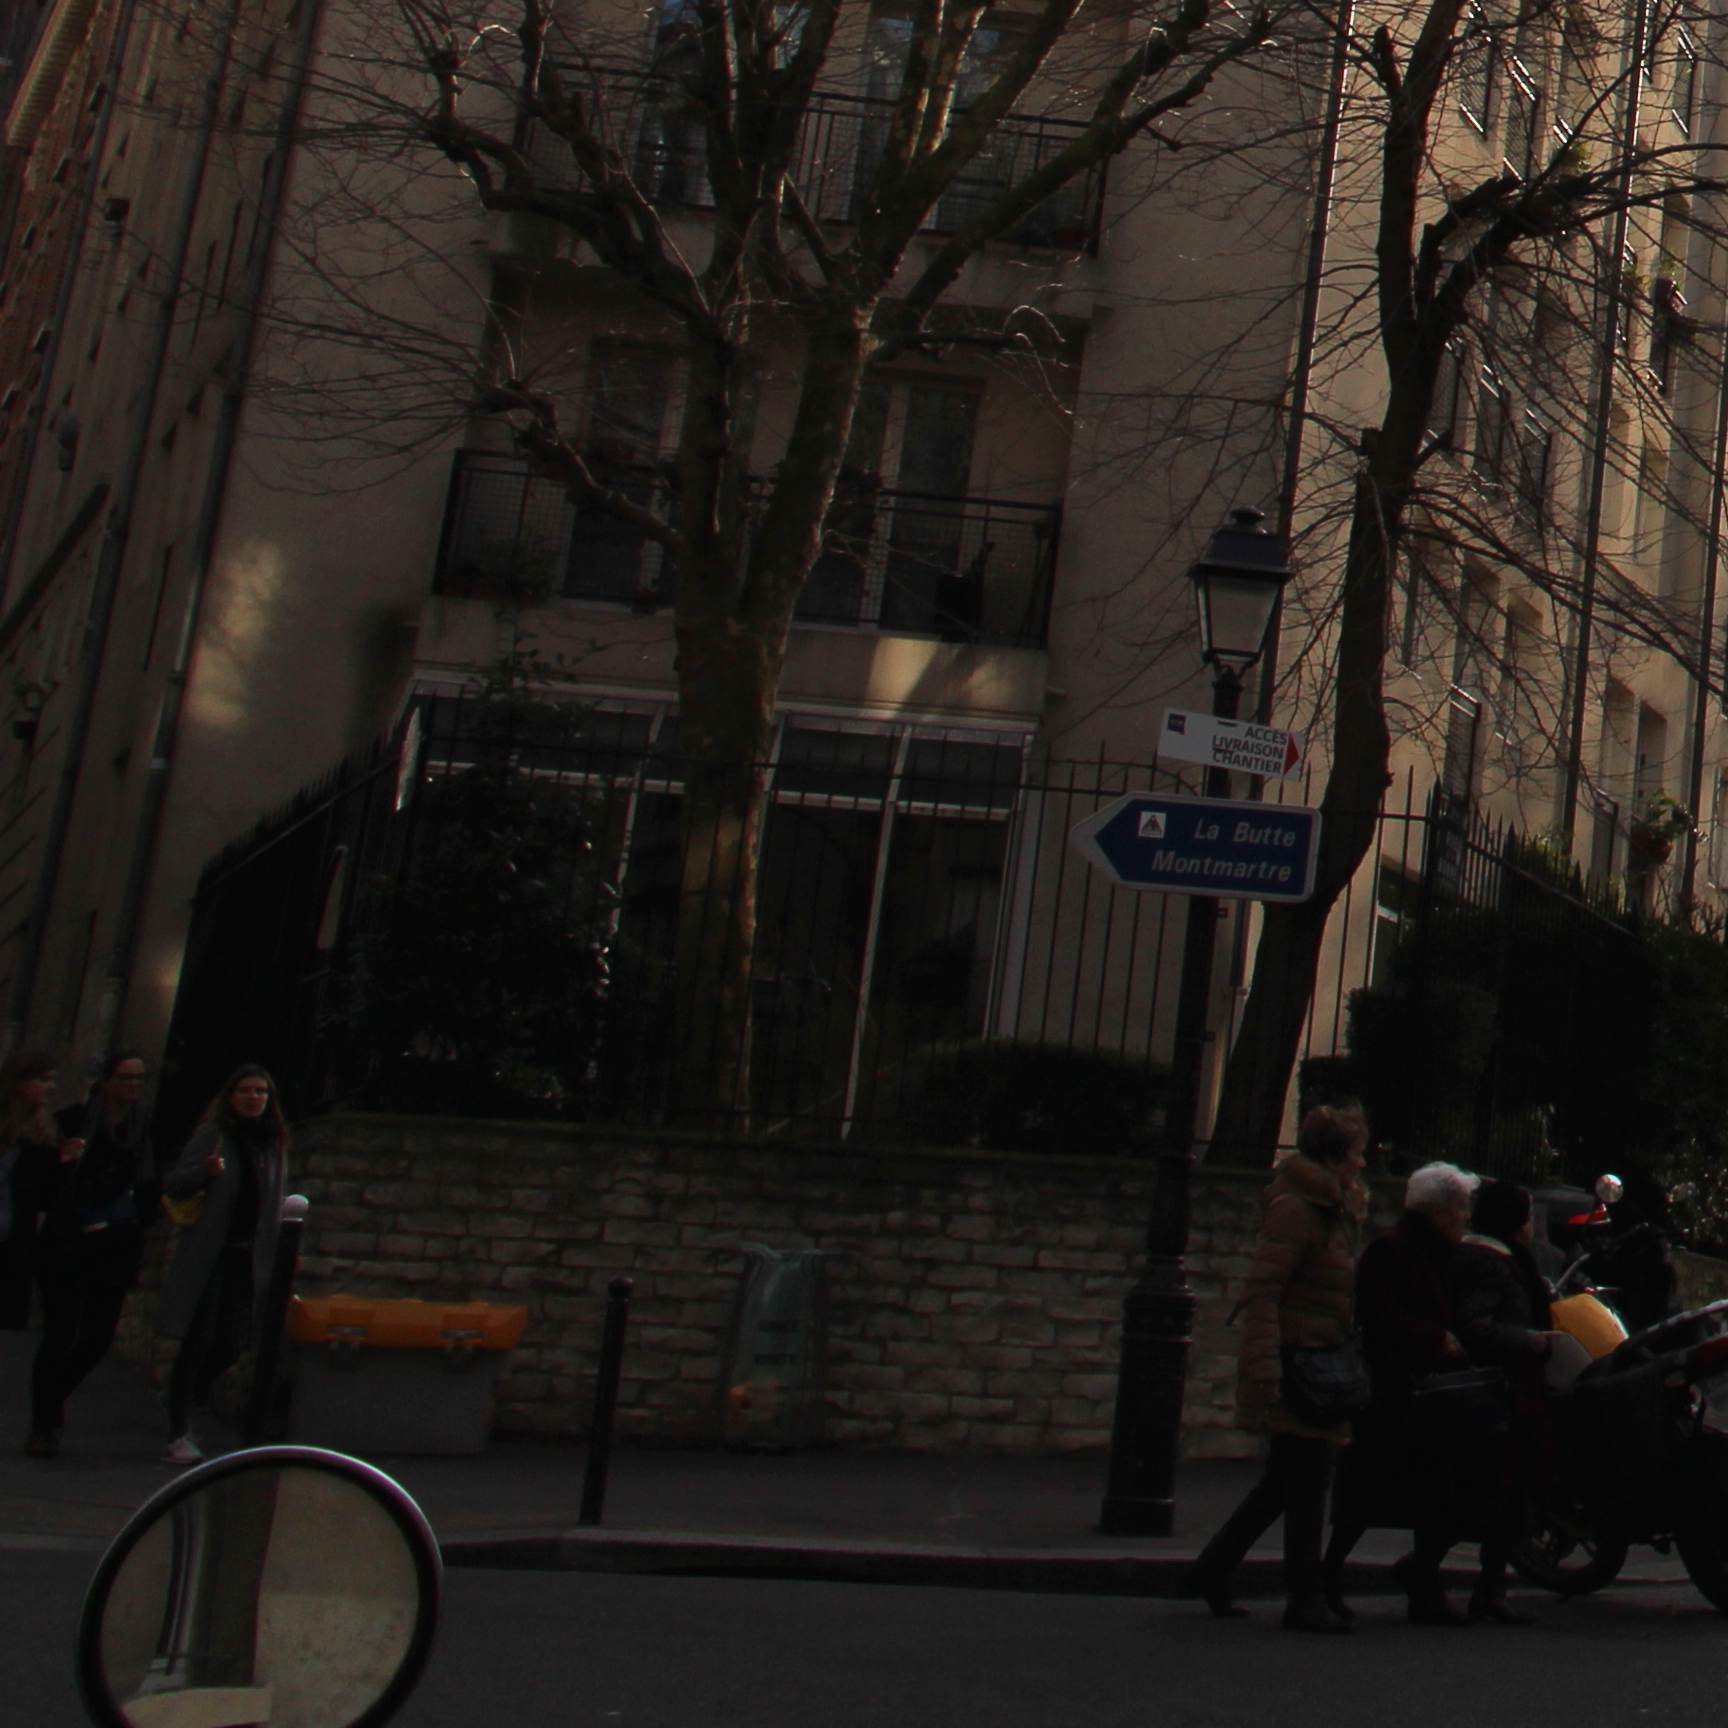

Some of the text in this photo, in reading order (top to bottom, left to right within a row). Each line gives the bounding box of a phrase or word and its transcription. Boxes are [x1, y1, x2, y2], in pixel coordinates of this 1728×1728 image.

[1212, 735, 1284, 759] LIVRAISON
[1245, 726, 1288, 745] ACCÈS
[1213, 750, 1282, 774] CHANTIER
[1193, 818, 1297, 847] La Butte
[1151, 849, 1293, 882] Montmartre
